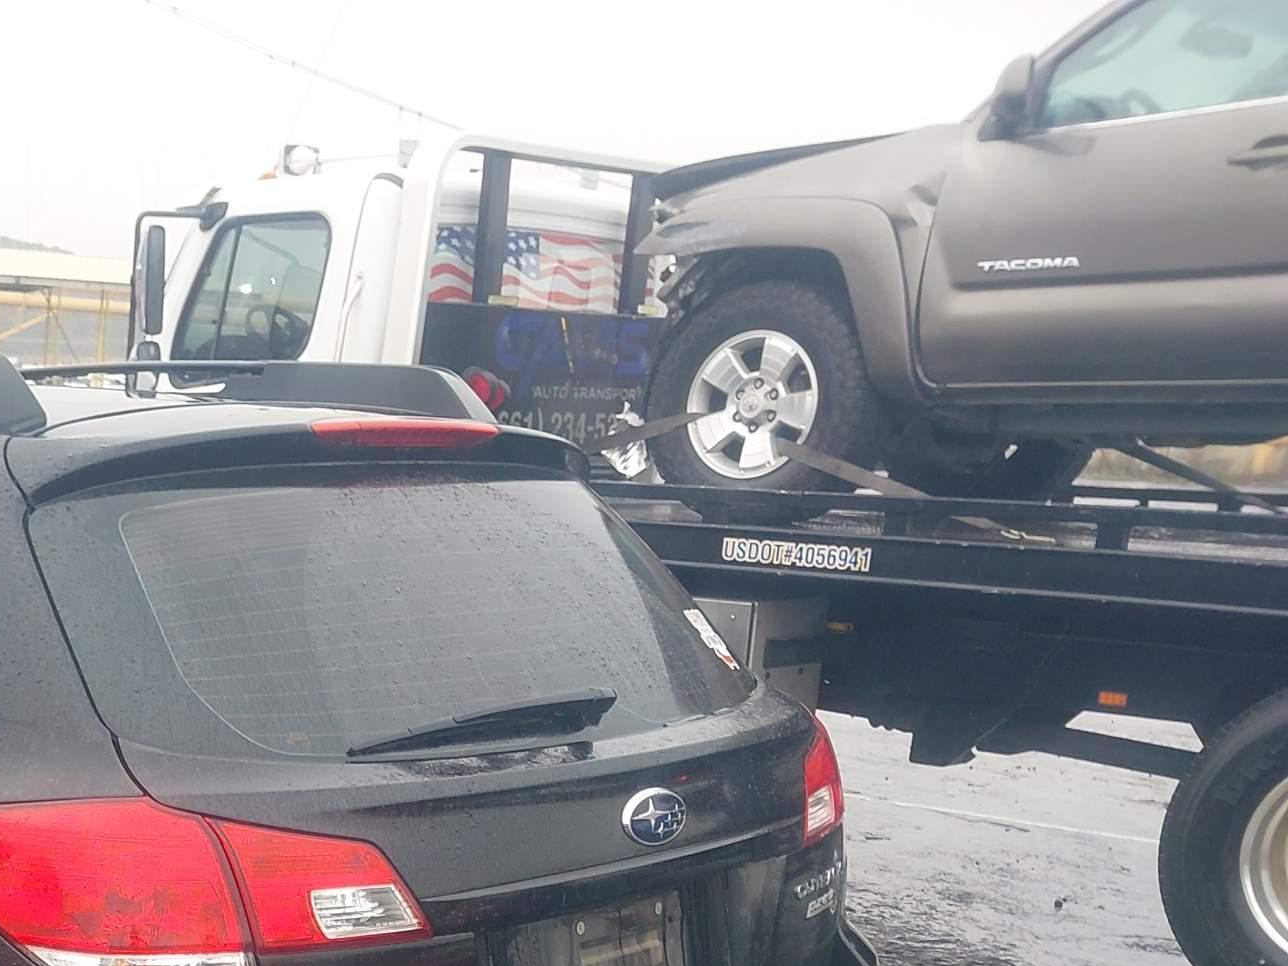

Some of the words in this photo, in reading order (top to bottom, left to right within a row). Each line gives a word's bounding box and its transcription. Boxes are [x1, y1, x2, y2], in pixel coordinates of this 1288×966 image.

[977, 256, 1080, 272] TACOMA
[532, 384, 568, 399] AUTO
[722, 537, 871, 571] USDOT#4056941
